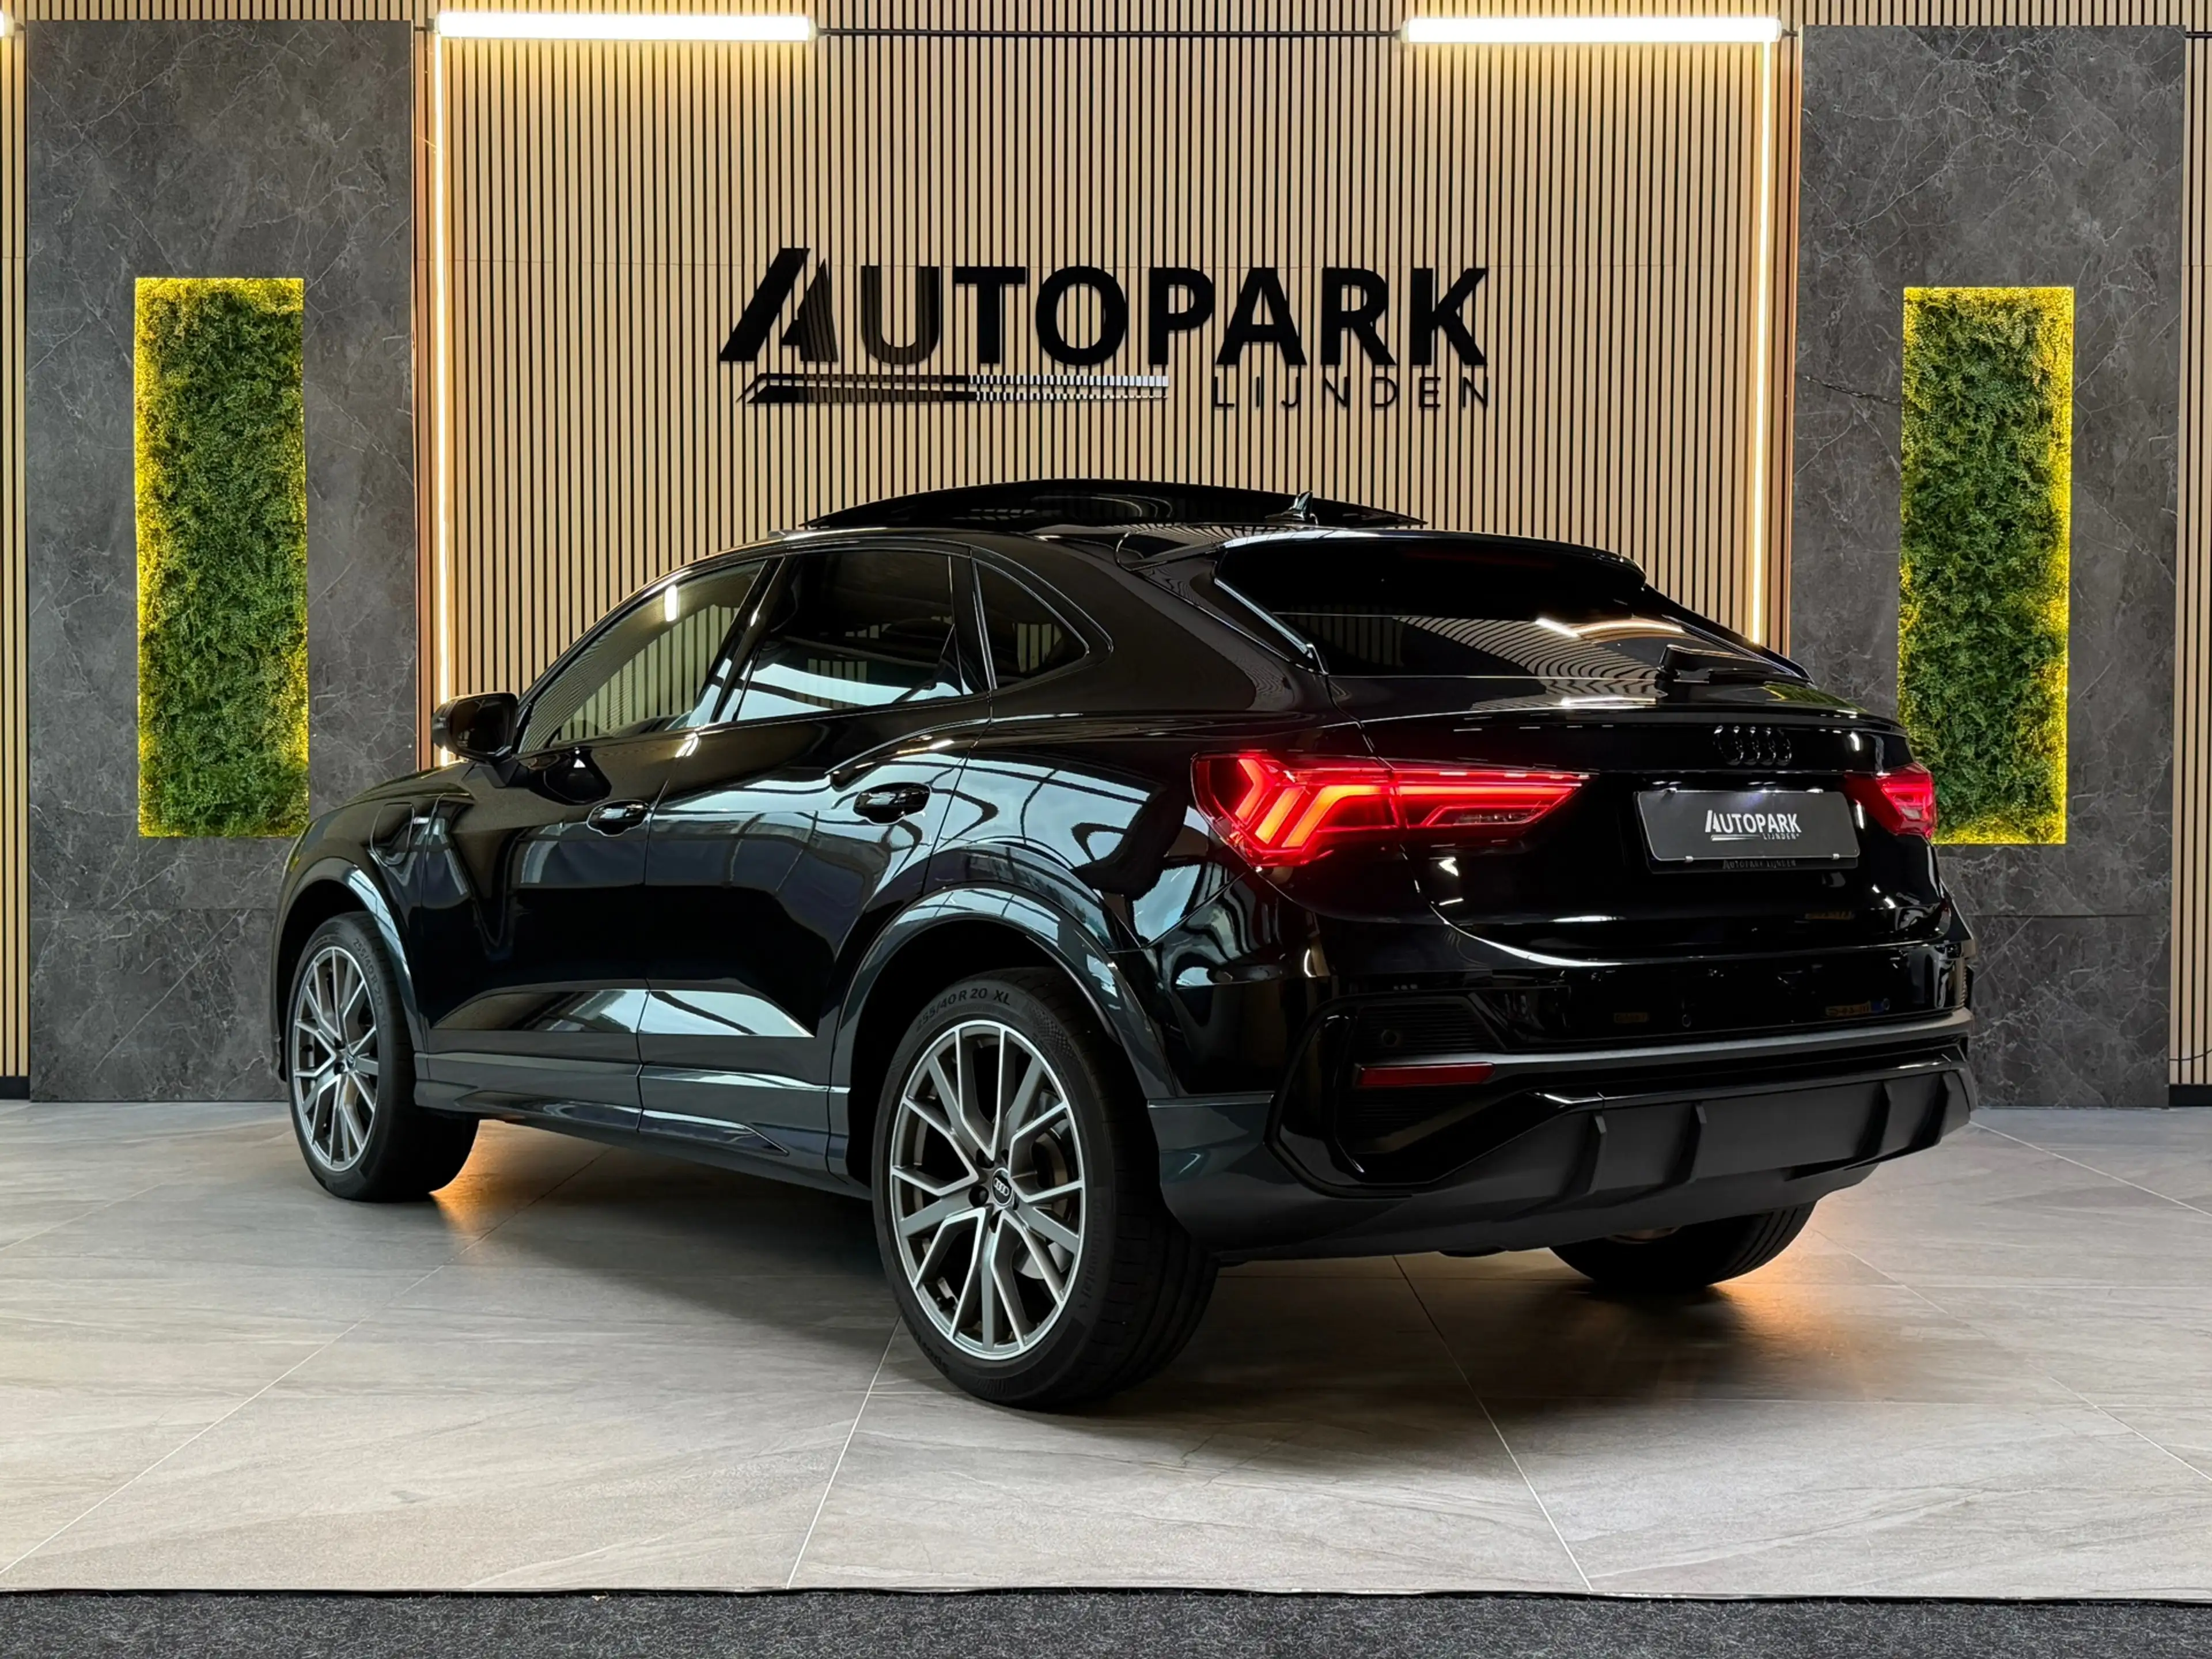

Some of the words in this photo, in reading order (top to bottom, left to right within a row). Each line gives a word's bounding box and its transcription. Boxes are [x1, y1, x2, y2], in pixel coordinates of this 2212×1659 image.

[718, 248, 1488, 366] AUTOPARK
[1213, 376, 1488, 408] LIJNDEN
[1705, 810, 1802, 834] AUTOPARK
[969, 987, 988, 999] 20
[992, 989, 1010, 1006] XL
